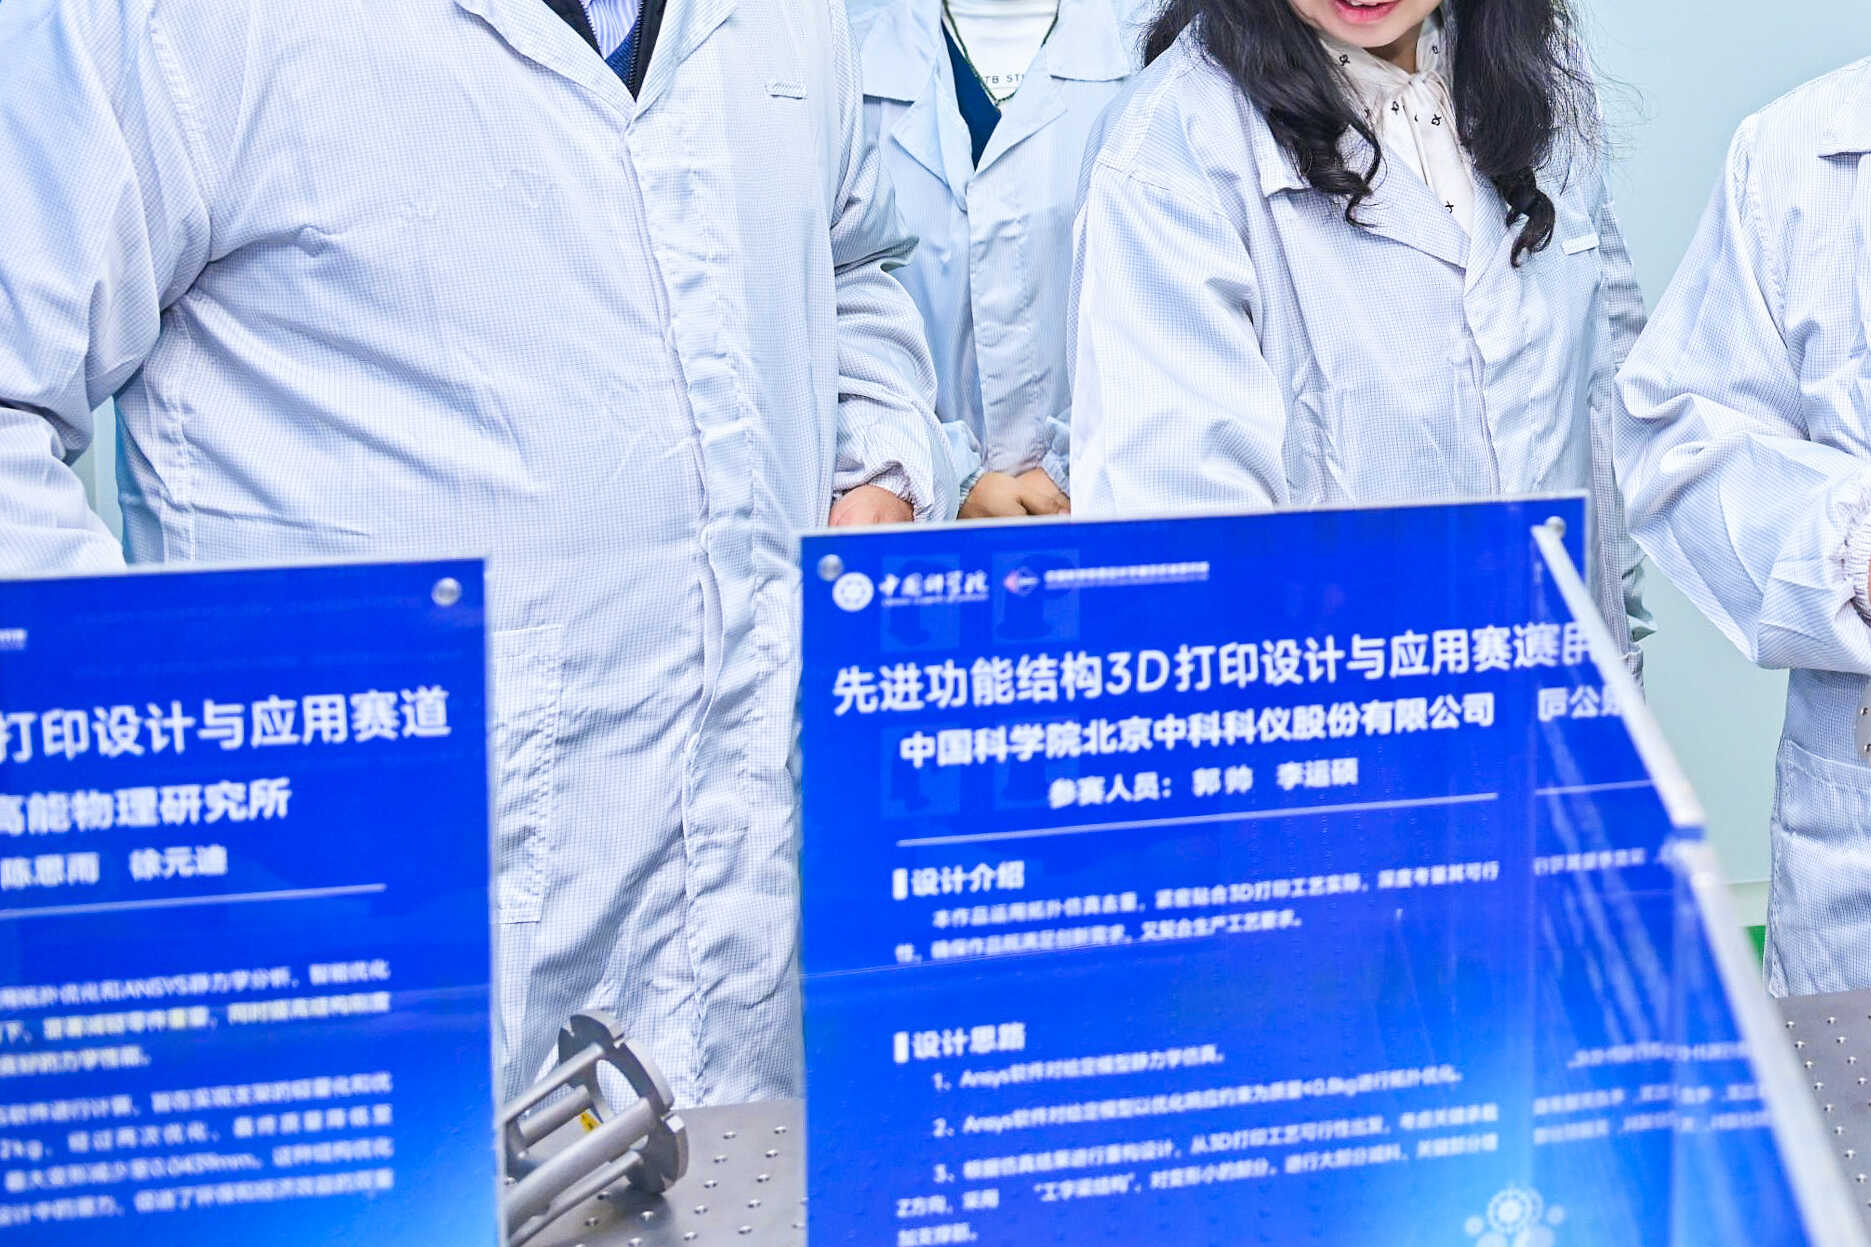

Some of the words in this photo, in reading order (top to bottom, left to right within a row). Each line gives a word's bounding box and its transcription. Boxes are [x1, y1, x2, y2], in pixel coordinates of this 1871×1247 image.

[899, 692, 1496, 770] 中国科学院北京中科科仪股份有限公司
[912, 859, 1025, 897] 设计介绍
